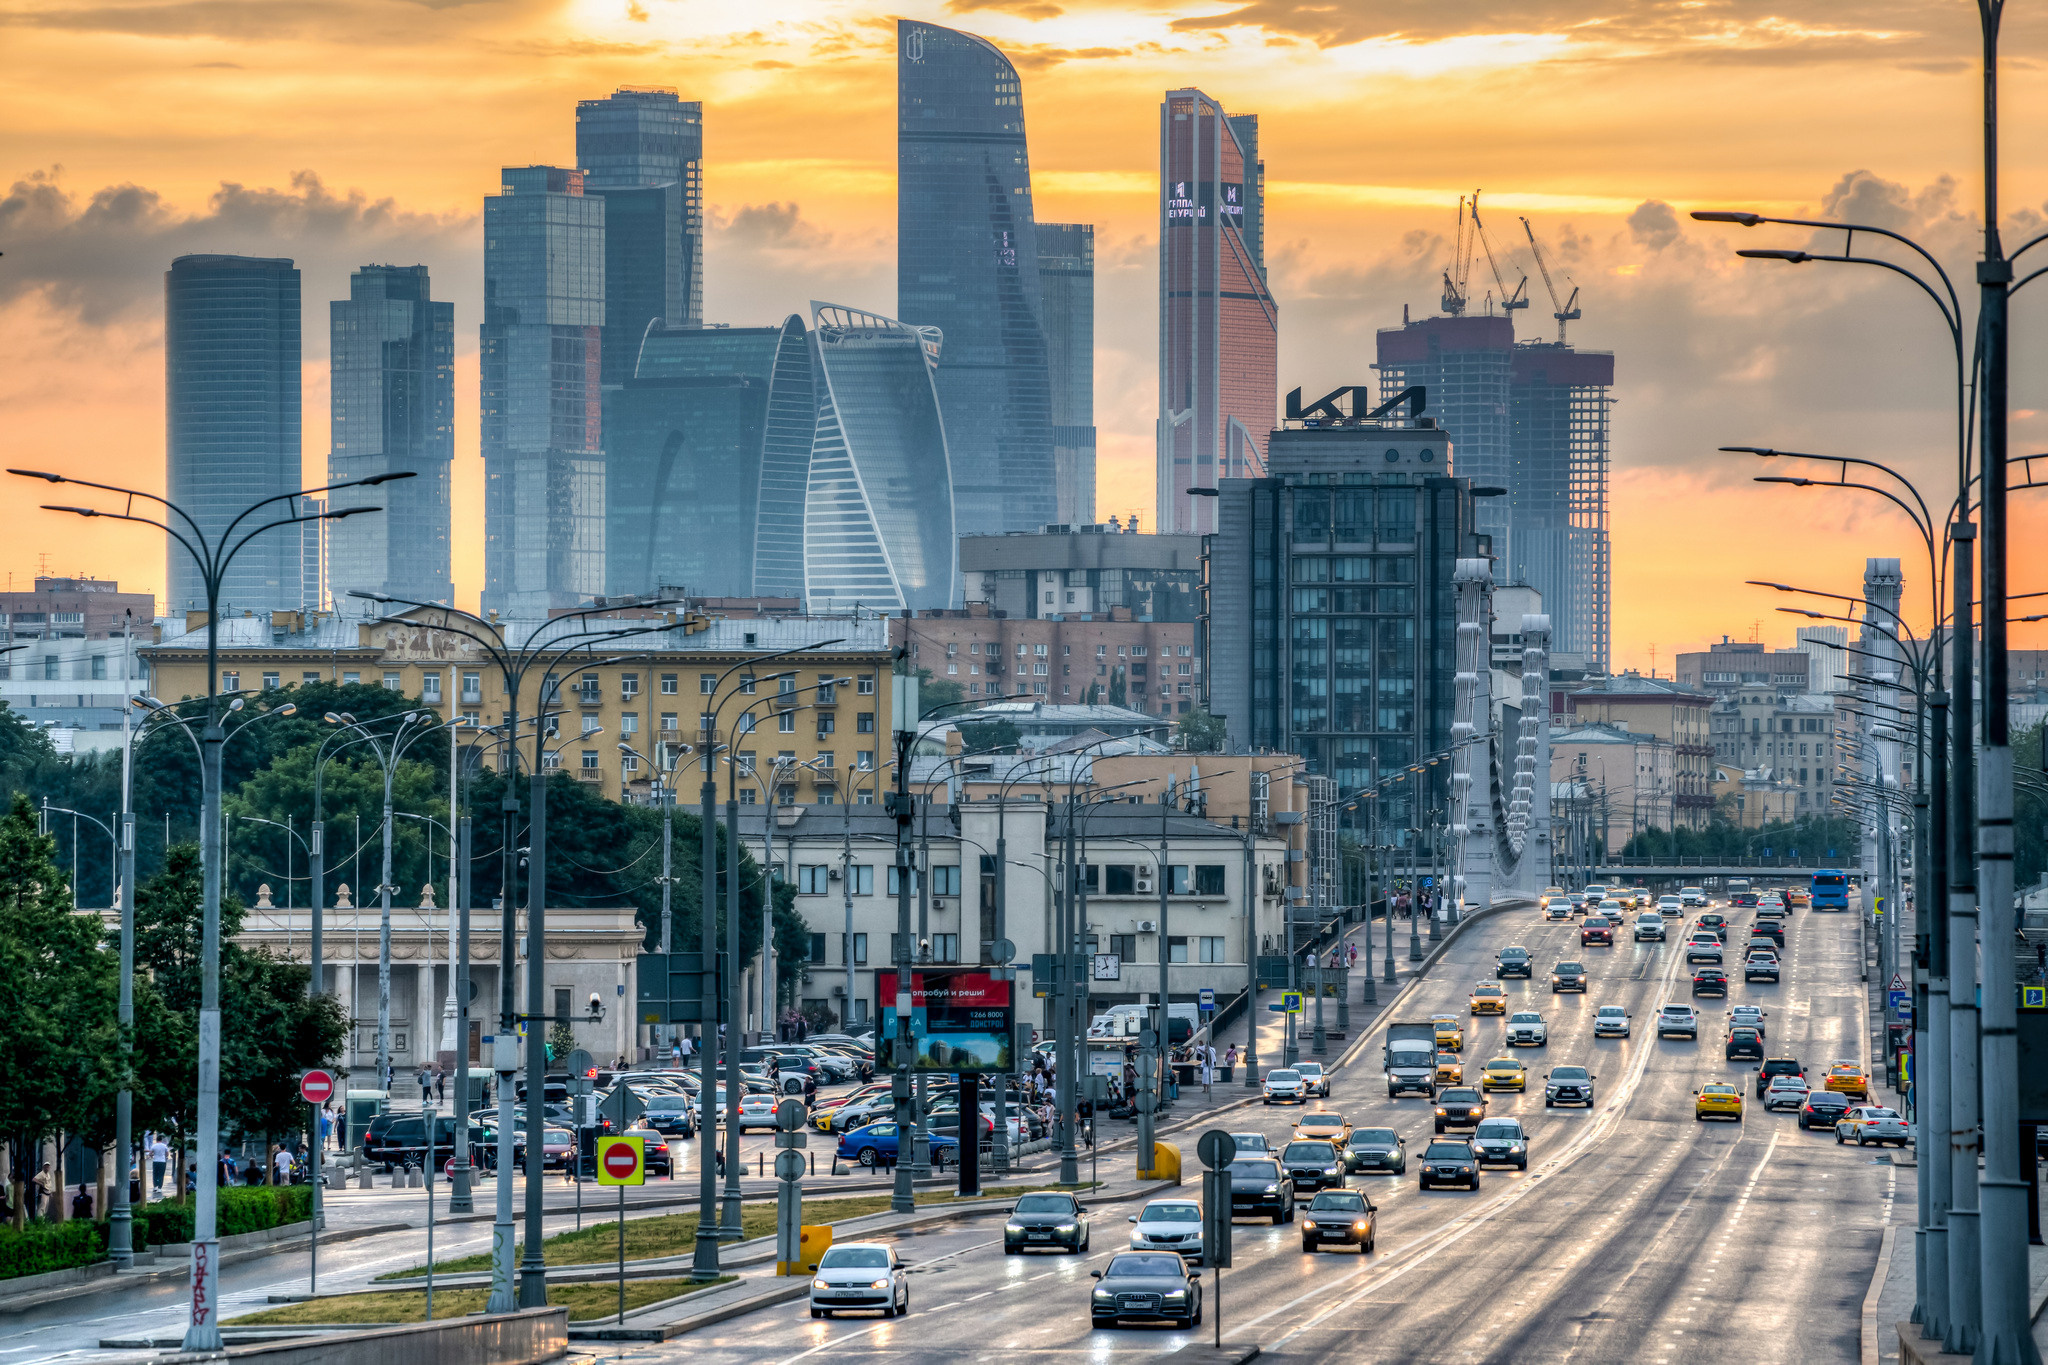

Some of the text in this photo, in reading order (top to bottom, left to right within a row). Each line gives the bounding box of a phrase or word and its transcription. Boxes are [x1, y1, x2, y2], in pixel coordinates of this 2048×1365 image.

[1286, 386, 1426, 418] KIA
[958, 988, 985, 997] реши!
[970, 1019, 1004, 1028] ДОНСТРОЙ
